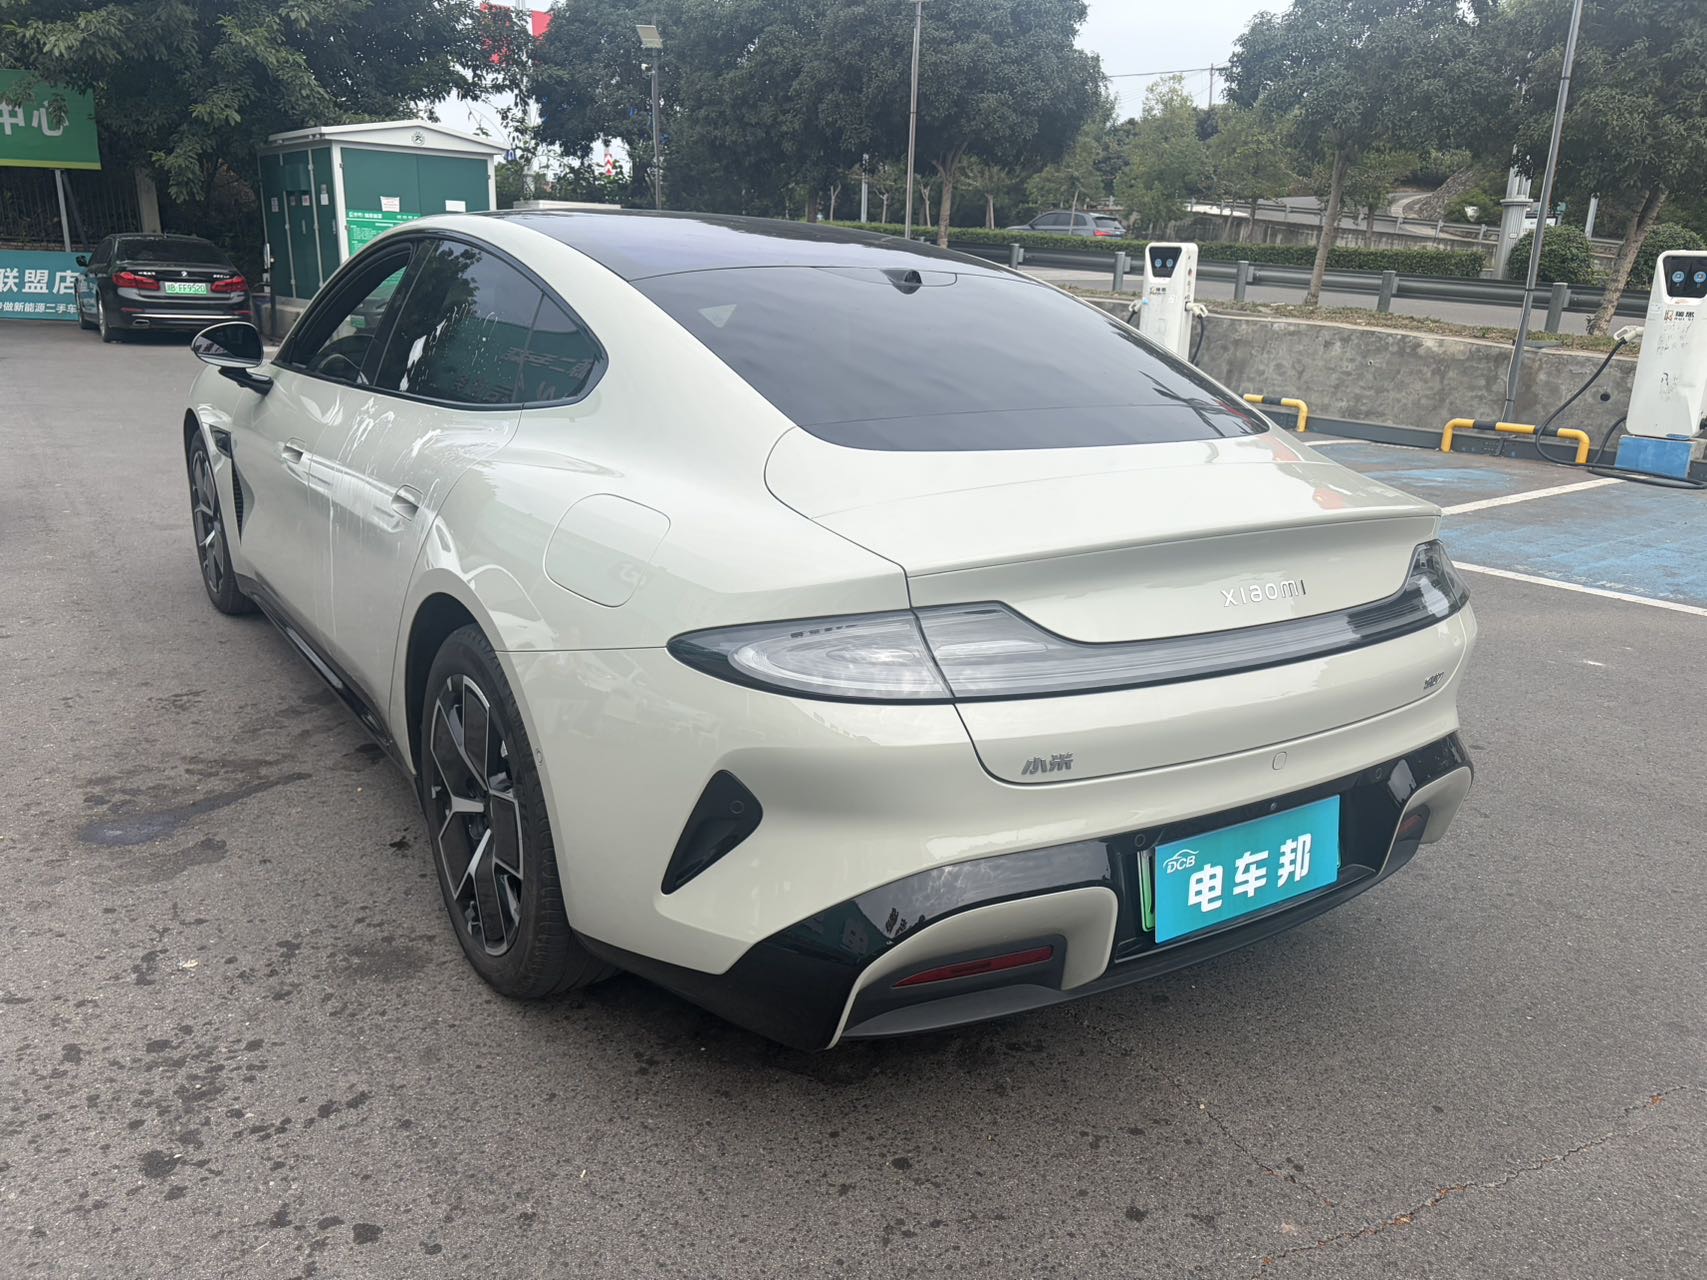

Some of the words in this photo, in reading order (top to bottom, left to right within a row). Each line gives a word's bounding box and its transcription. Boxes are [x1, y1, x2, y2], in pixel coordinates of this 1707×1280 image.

[0, 268, 80, 294] 联盟店
[0, 301, 77, 314] 做新能源二手车
[1021, 753, 1073, 775] 小米
[1166, 855, 1196, 874] DCB
[1187, 833, 1312, 913] 电车邦
